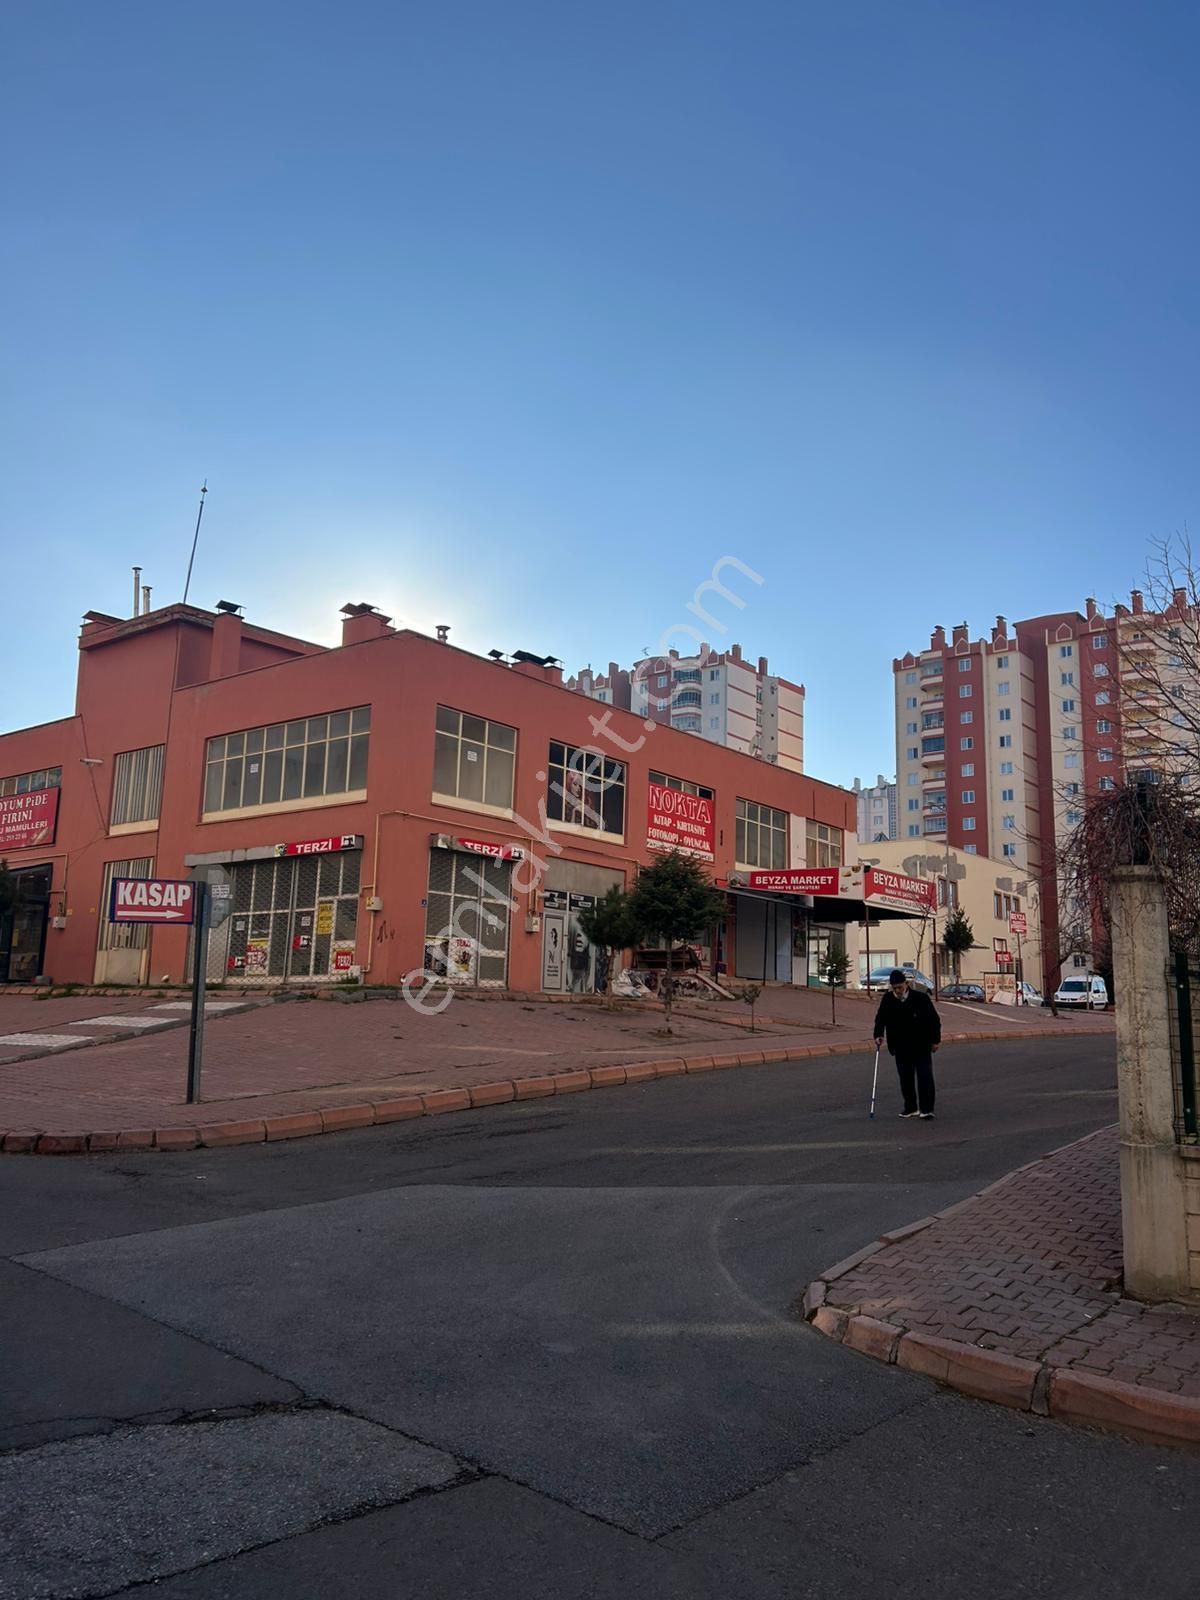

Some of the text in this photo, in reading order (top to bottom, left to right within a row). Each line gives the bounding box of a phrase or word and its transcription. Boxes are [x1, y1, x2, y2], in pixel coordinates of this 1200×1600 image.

[649, 785, 711, 824] NOKTA
[2, 810, 33, 824] FIRINI
[295, 838, 333, 854] TERZİ
[464, 841, 504, 857] TERZİ
[755, 876, 834, 885] BEYZA MARKET
[873, 872, 899, 889] BEYZA
[899, 878, 929, 895] MARKET
[117, 881, 191, 907] KASAP
